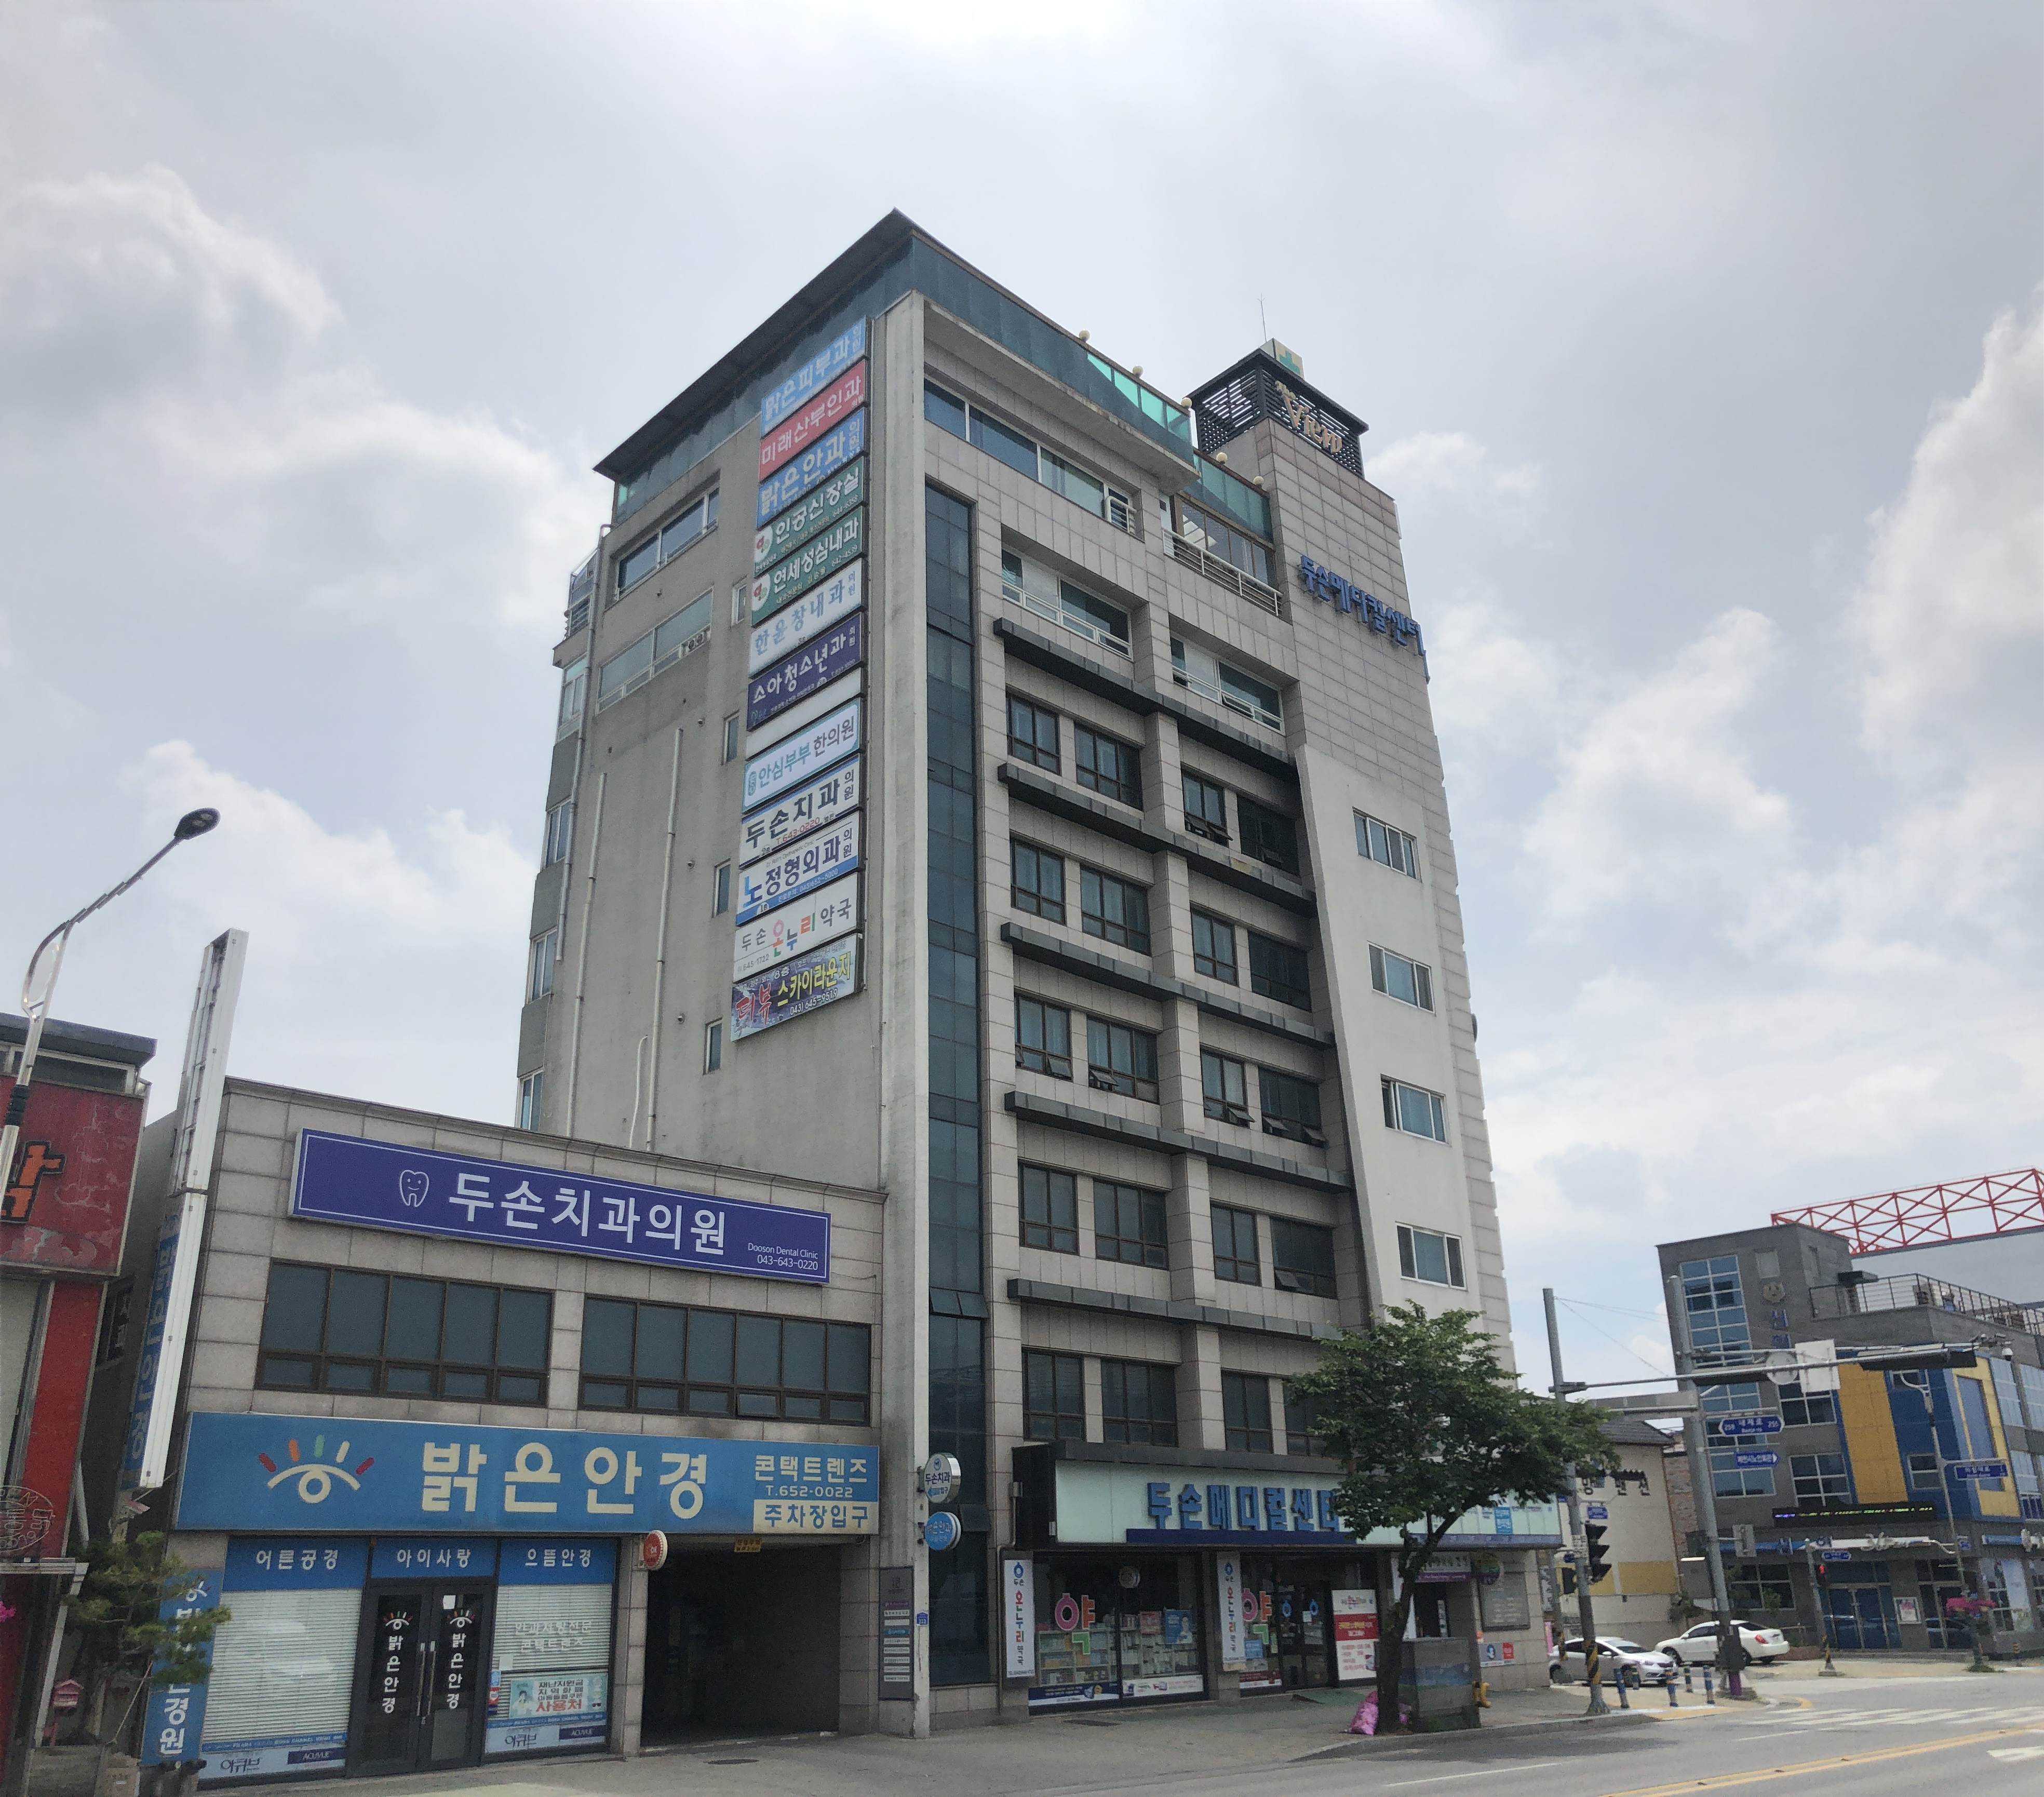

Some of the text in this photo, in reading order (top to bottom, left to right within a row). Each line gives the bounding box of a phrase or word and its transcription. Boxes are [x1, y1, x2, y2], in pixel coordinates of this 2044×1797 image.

[762, 376, 861, 464] 미래산부인과
[776, 467, 858, 544] 인공신장실
[774, 517, 858, 594] 연세성심내과
[753, 633, 846, 703] 소아청소년과
[758, 743, 811, 788] 안심부부
[813, 716, 855, 758] 한의원
[746, 778, 840, 849] 두손치과
[844, 769, 855, 800] 의원
[743, 828, 852, 908] 노정형외과 의원
[742, 928, 766, 951] 두손
[773, 913, 815, 957] 온누리
[821, 898, 852, 927] 약국
[777, 951, 851, 1007] 스카이라운지
[790, 988, 838, 1015] 043) 645-9519
[449, 1173, 724, 1255] 두손치과의원
[748, 1242, 818, 1259] Dooson Dental Clinic
[757, 1254, 818, 1270] 043-643-0220
[422, 1442, 707, 1519] 밝은안경
[755, 1455, 868, 1483] 콘택트렌즈
[925, 1471, 950, 1485] 두손치과
[765, 1484, 853, 1498] T.652-0022
[764, 1504, 868, 1529] 주차장입구
[256, 1549, 338, 1571] 어른공경
[397, 1548, 471, 1568] 아이사랑
[525, 1548, 591, 1567] 으뜸안경
[1055, 1592, 1095, 1655] 약
[1242, 1588, 1272, 1645] 약
[382, 1635, 404, 1713] 밝은안경
[447, 1633, 466, 1709] 밝은안경
[538, 1686, 584, 1695] 지역화폐
[539, 1679, 584, 1688] 재난지원금
[536, 1699, 582, 1712] 사용처
[505, 1733, 537, 1748] 아큐브
[220, 1757, 260, 1773] 아큐브
